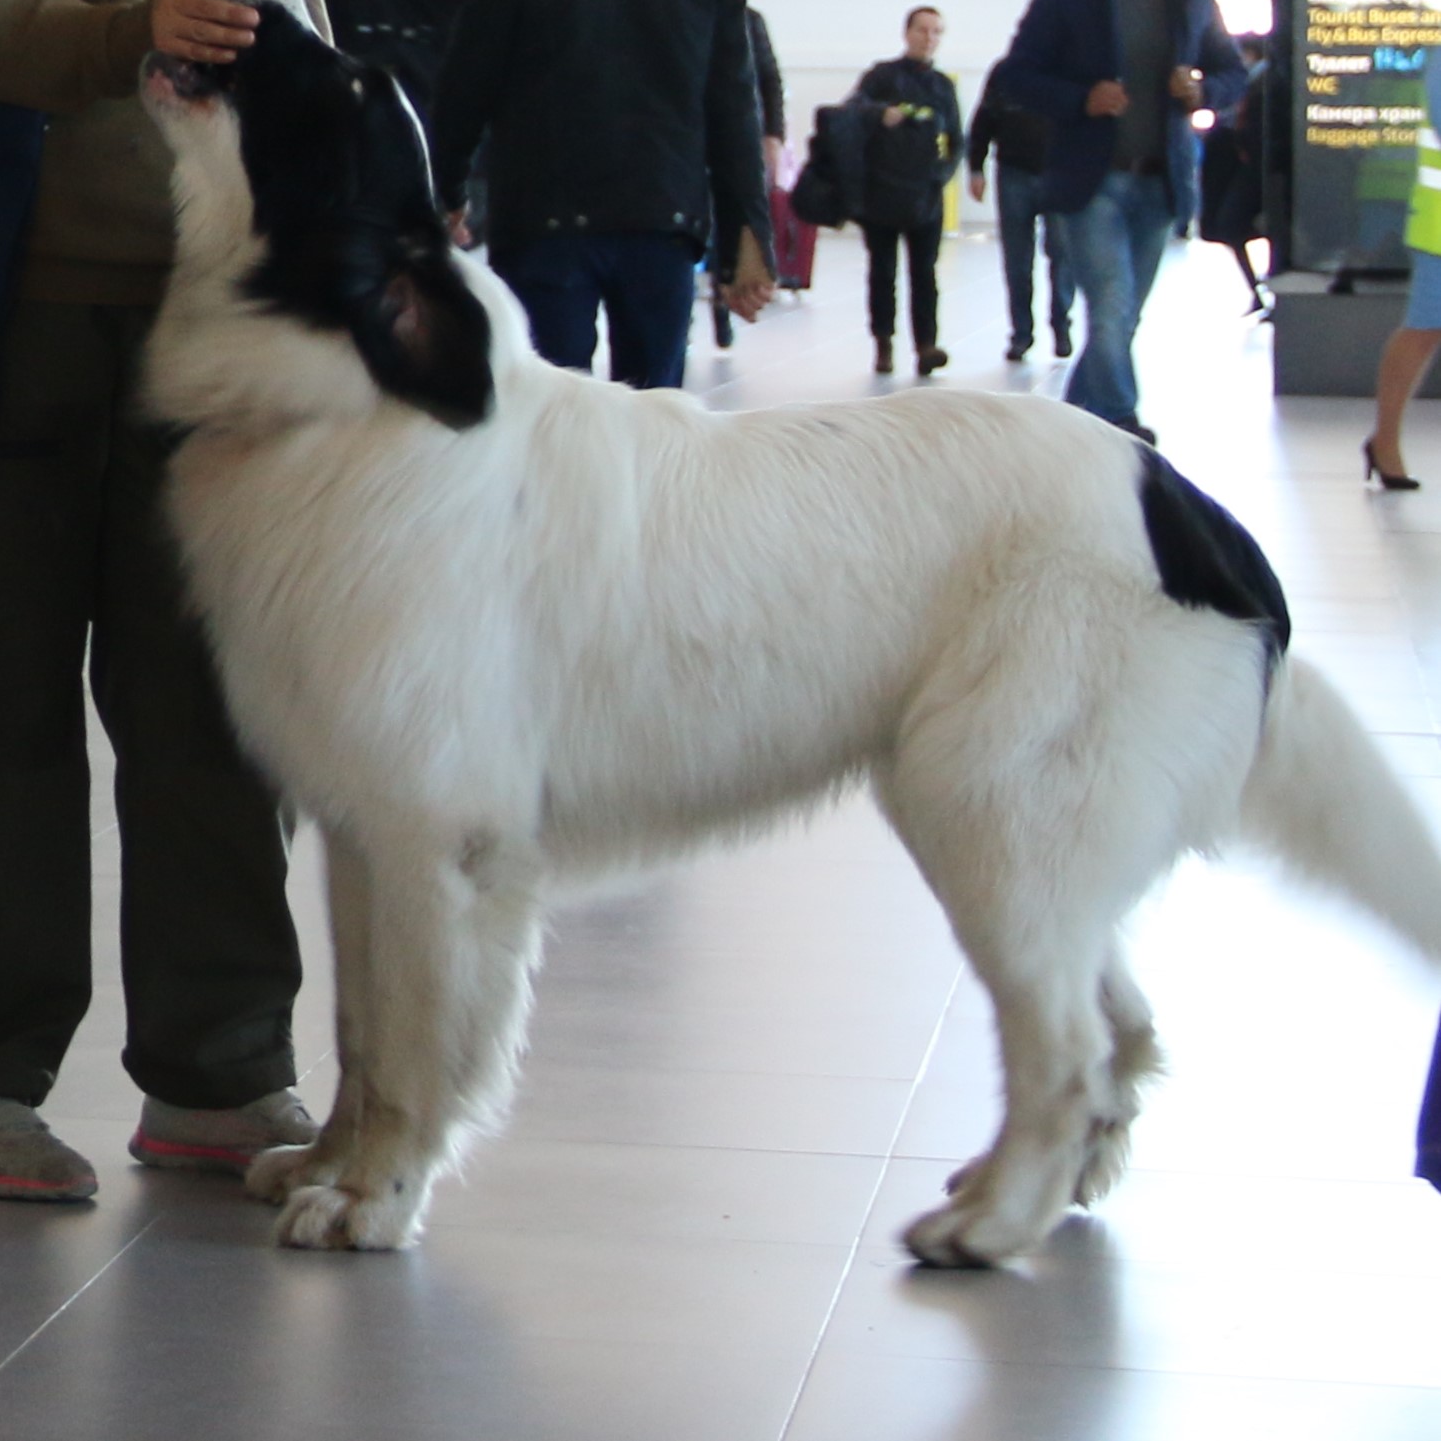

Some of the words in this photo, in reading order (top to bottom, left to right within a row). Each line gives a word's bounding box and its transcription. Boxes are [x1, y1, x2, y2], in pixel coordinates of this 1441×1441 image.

[1307, 8, 1365, 24] Tourist
[1368, 8, 1417, 24] Buses
[1381, 27, 1441, 47] Express
[1307, 105, 1378, 125] Камера
[1379, 106, 1425, 125] хран
[1381, 127, 1418, 143] Stor
